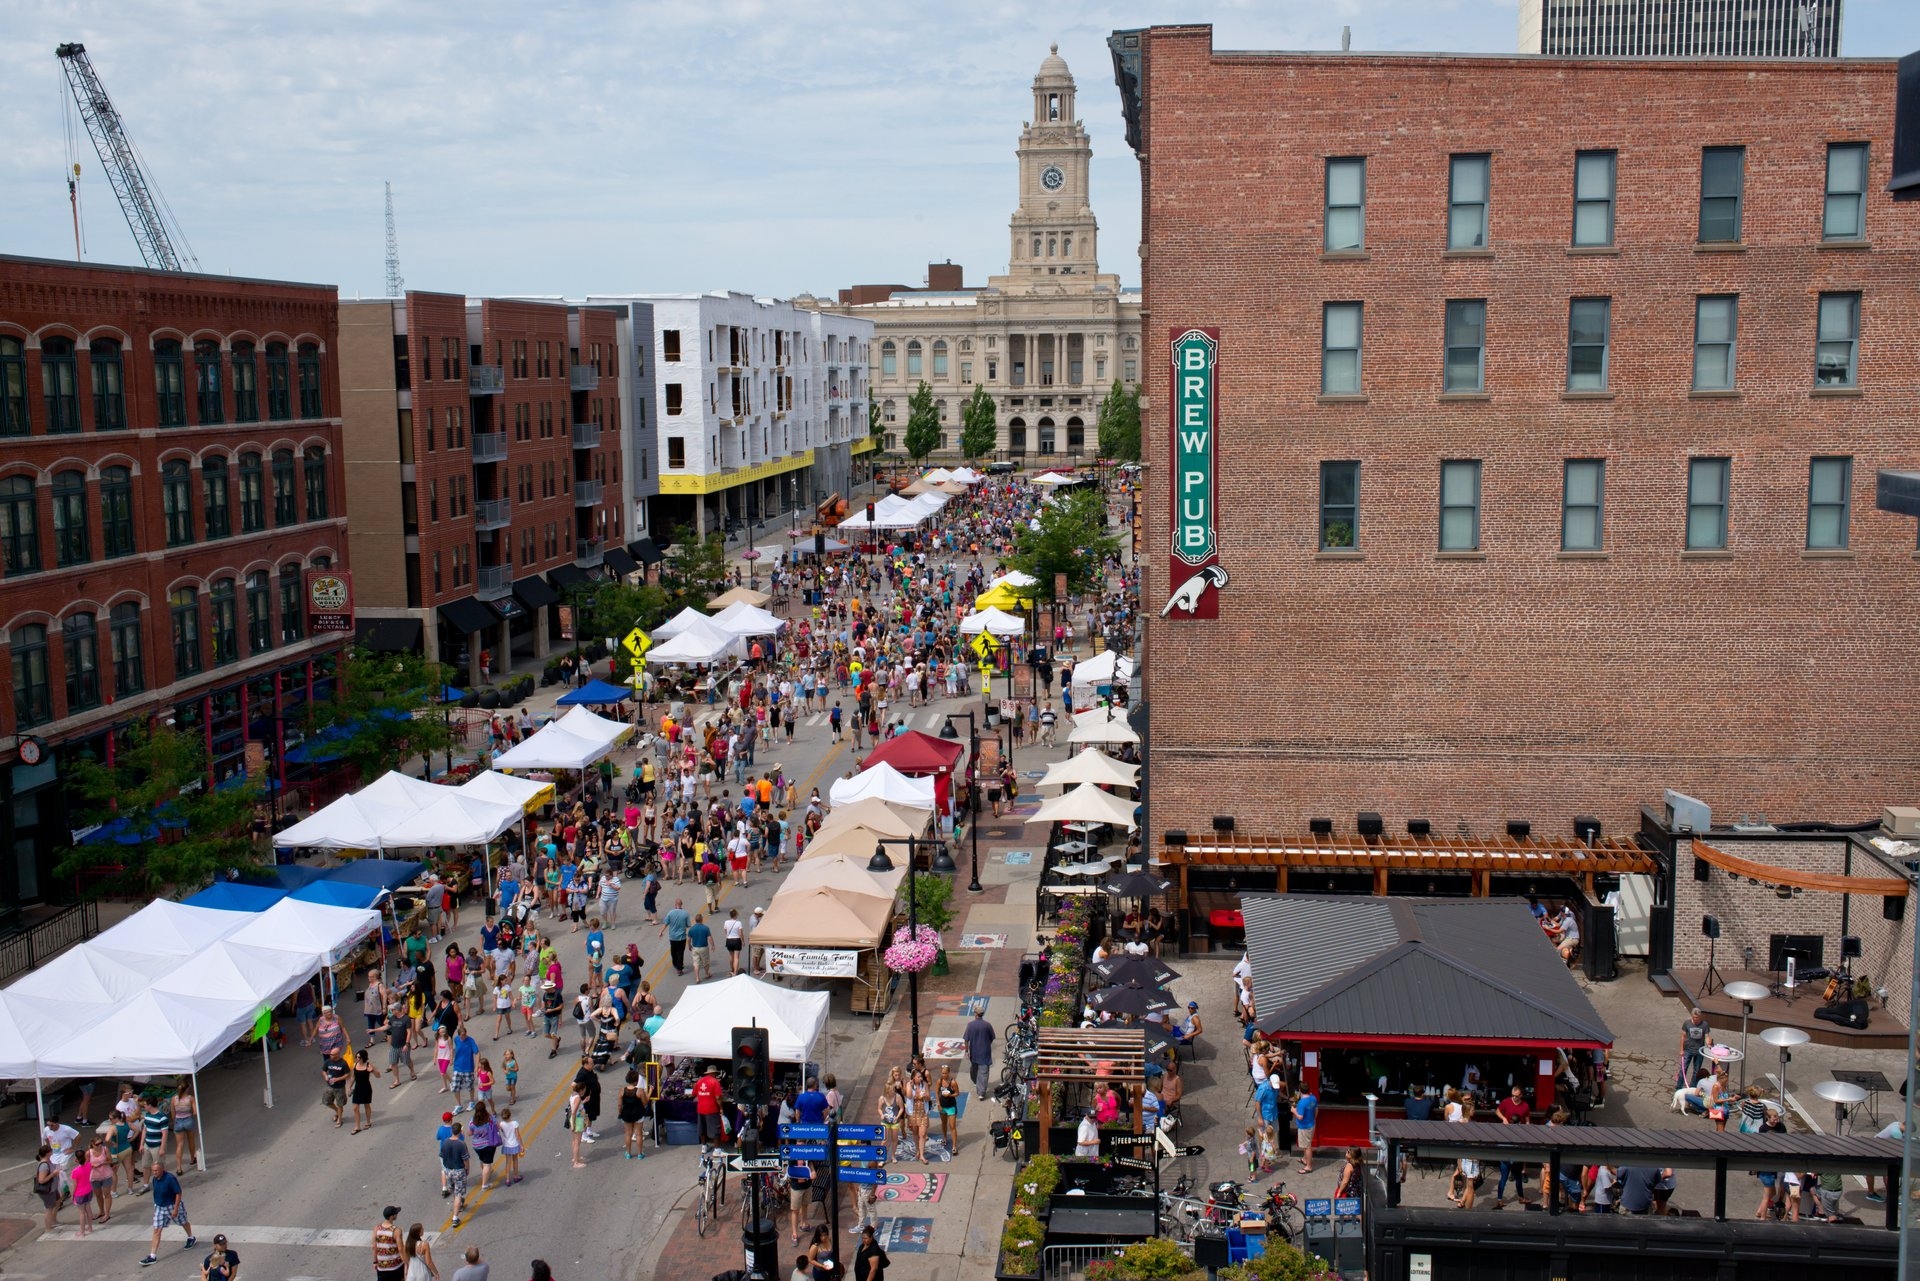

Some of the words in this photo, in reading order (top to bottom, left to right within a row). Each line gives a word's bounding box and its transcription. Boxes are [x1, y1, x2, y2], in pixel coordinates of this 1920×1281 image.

[1180, 348, 1208, 453] BREW
[1184, 471, 1206, 547] PUB
[798, 952, 828, 961] Family
[1146, 1002, 1167, 1010] GUINNESS
[1148, 1040, 1167, 1054] GUINNESS
[1120, 1161, 1152, 1170] CONVERSATION
